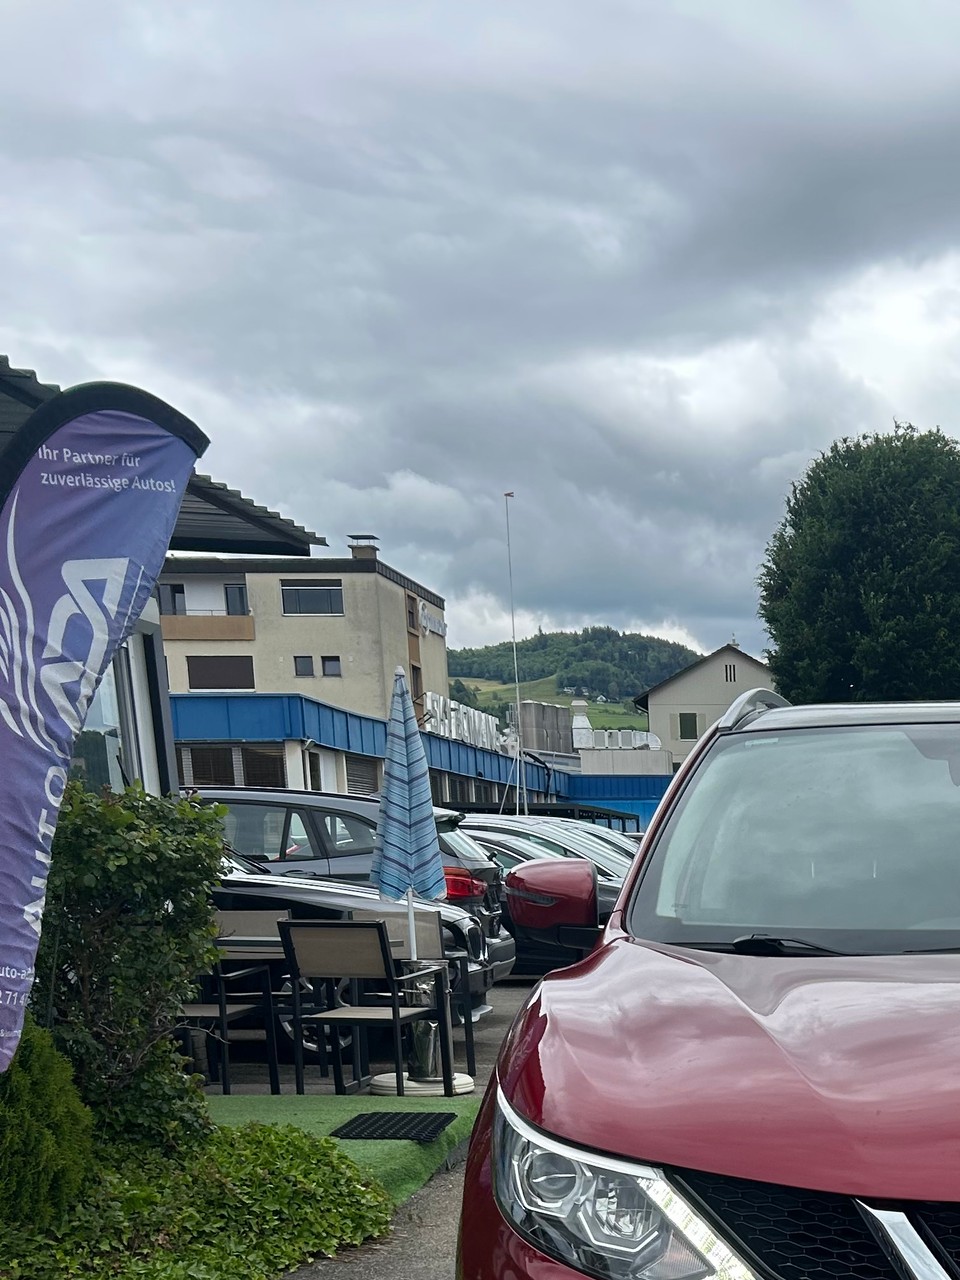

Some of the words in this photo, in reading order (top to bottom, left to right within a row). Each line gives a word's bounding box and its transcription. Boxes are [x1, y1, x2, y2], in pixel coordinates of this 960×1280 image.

[38, 444, 59, 461] Ihr
[63, 448, 119, 466] Partner
[121, 452, 141, 467] für
[40, 473, 130, 492] zuverlässige
[131, 476, 177, 493] Autos!
